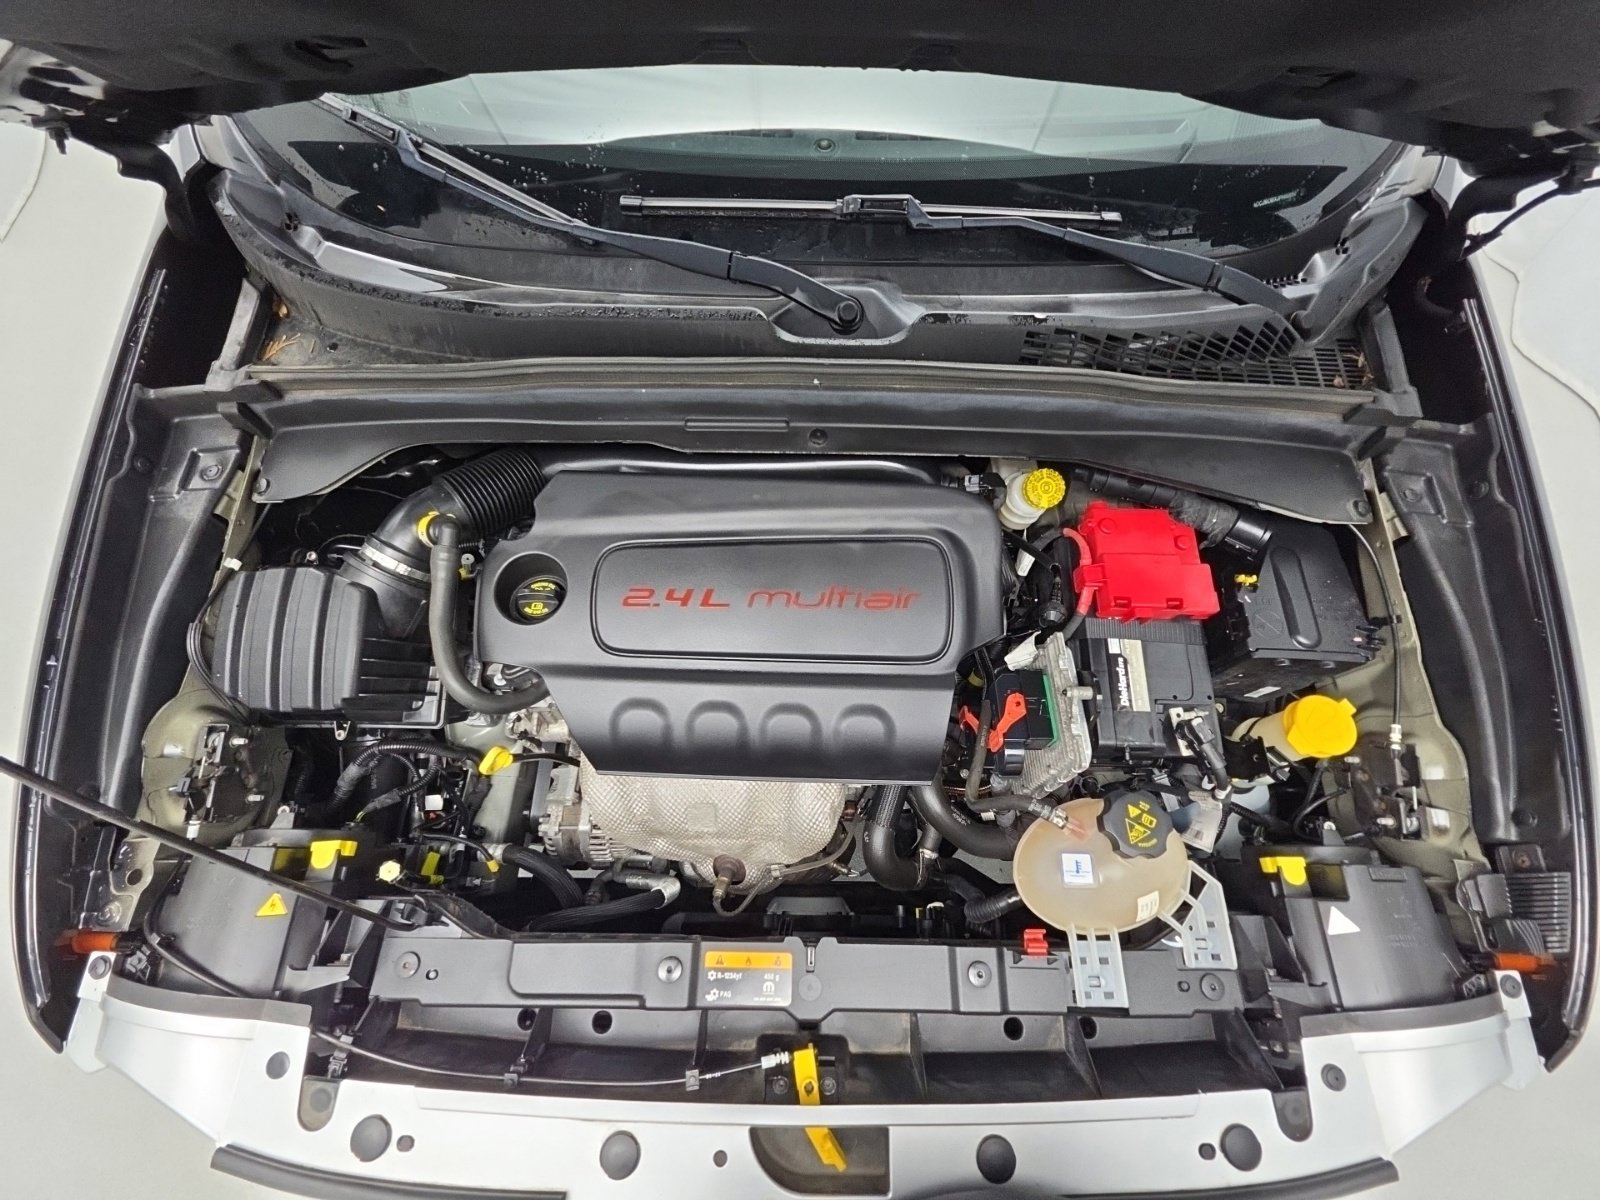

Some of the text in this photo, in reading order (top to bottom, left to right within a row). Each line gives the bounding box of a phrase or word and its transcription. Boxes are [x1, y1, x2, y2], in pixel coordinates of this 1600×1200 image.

[622, 585, 922, 609] 2.4L multiair
[1115, 666, 1130, 707] DieHard
